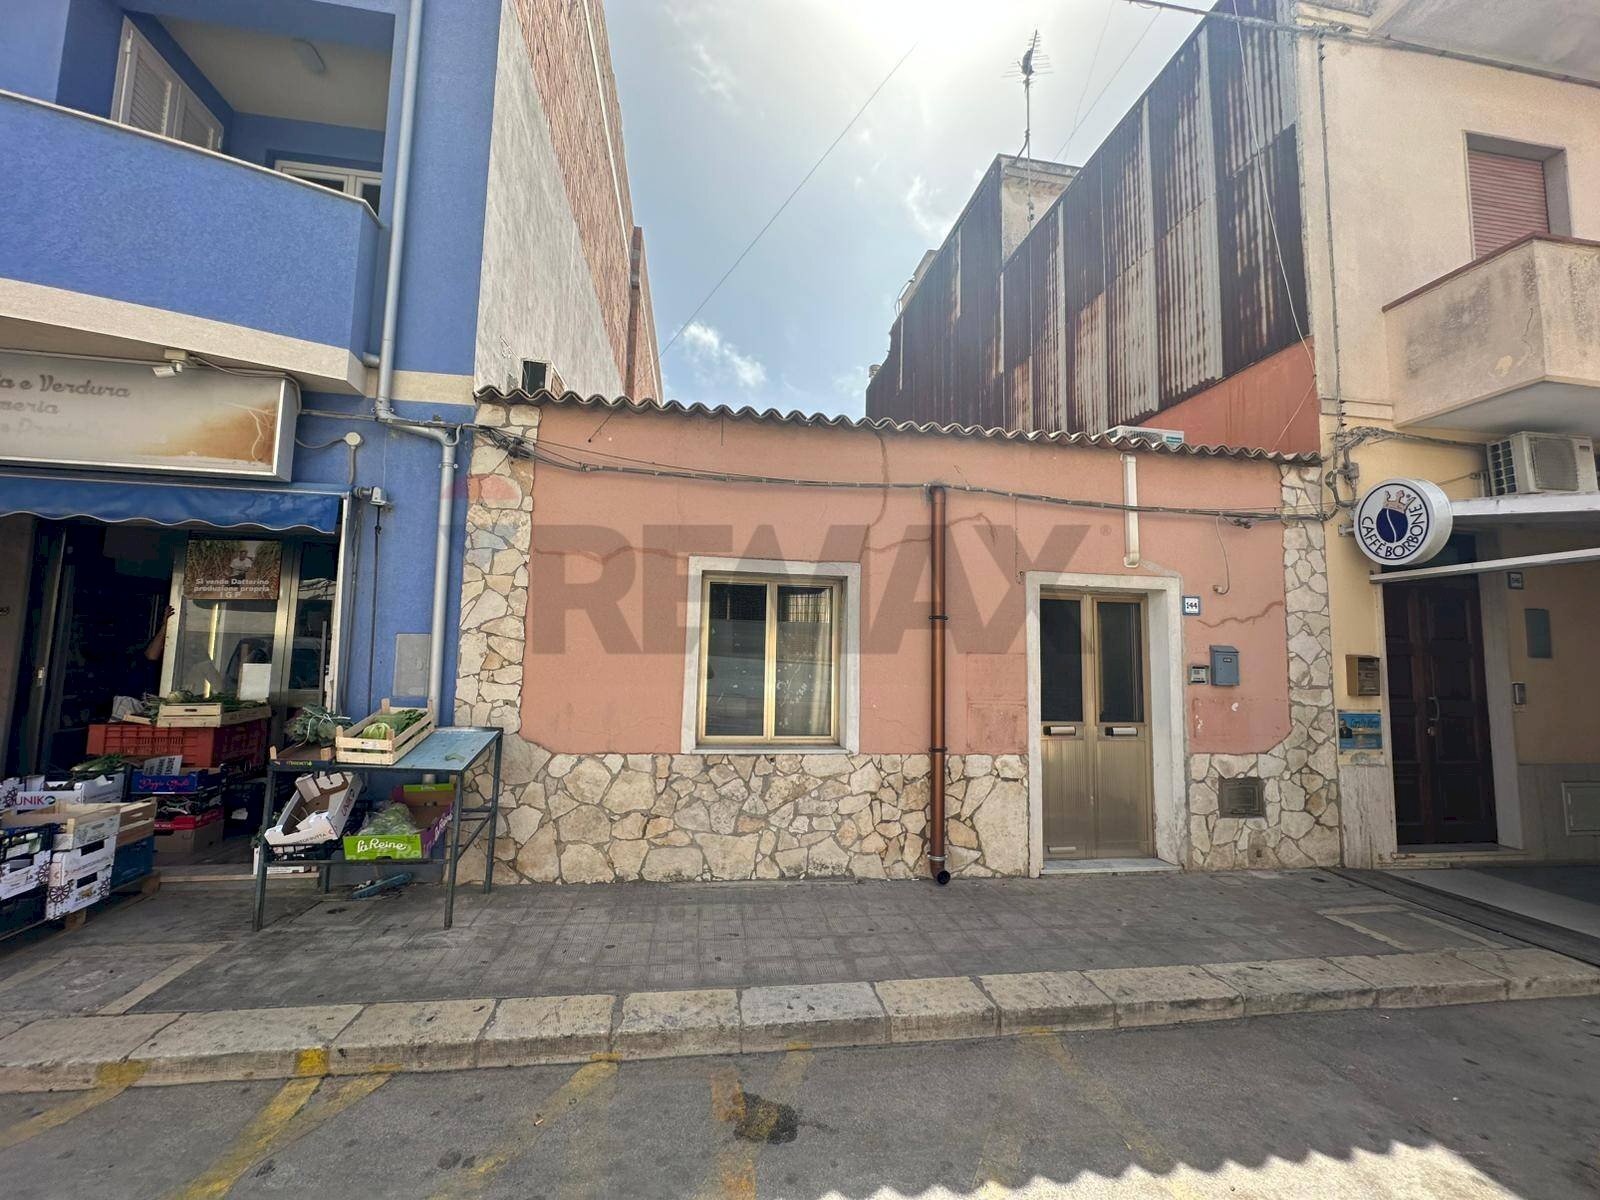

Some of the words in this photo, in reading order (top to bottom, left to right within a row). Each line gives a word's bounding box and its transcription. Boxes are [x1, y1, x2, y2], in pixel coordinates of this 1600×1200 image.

[20, 380, 32, 390] e
[40, 374, 130, 397] Verdura
[1385, 504, 1425, 557] BORBONE
[369, 838, 407, 850] Reine
